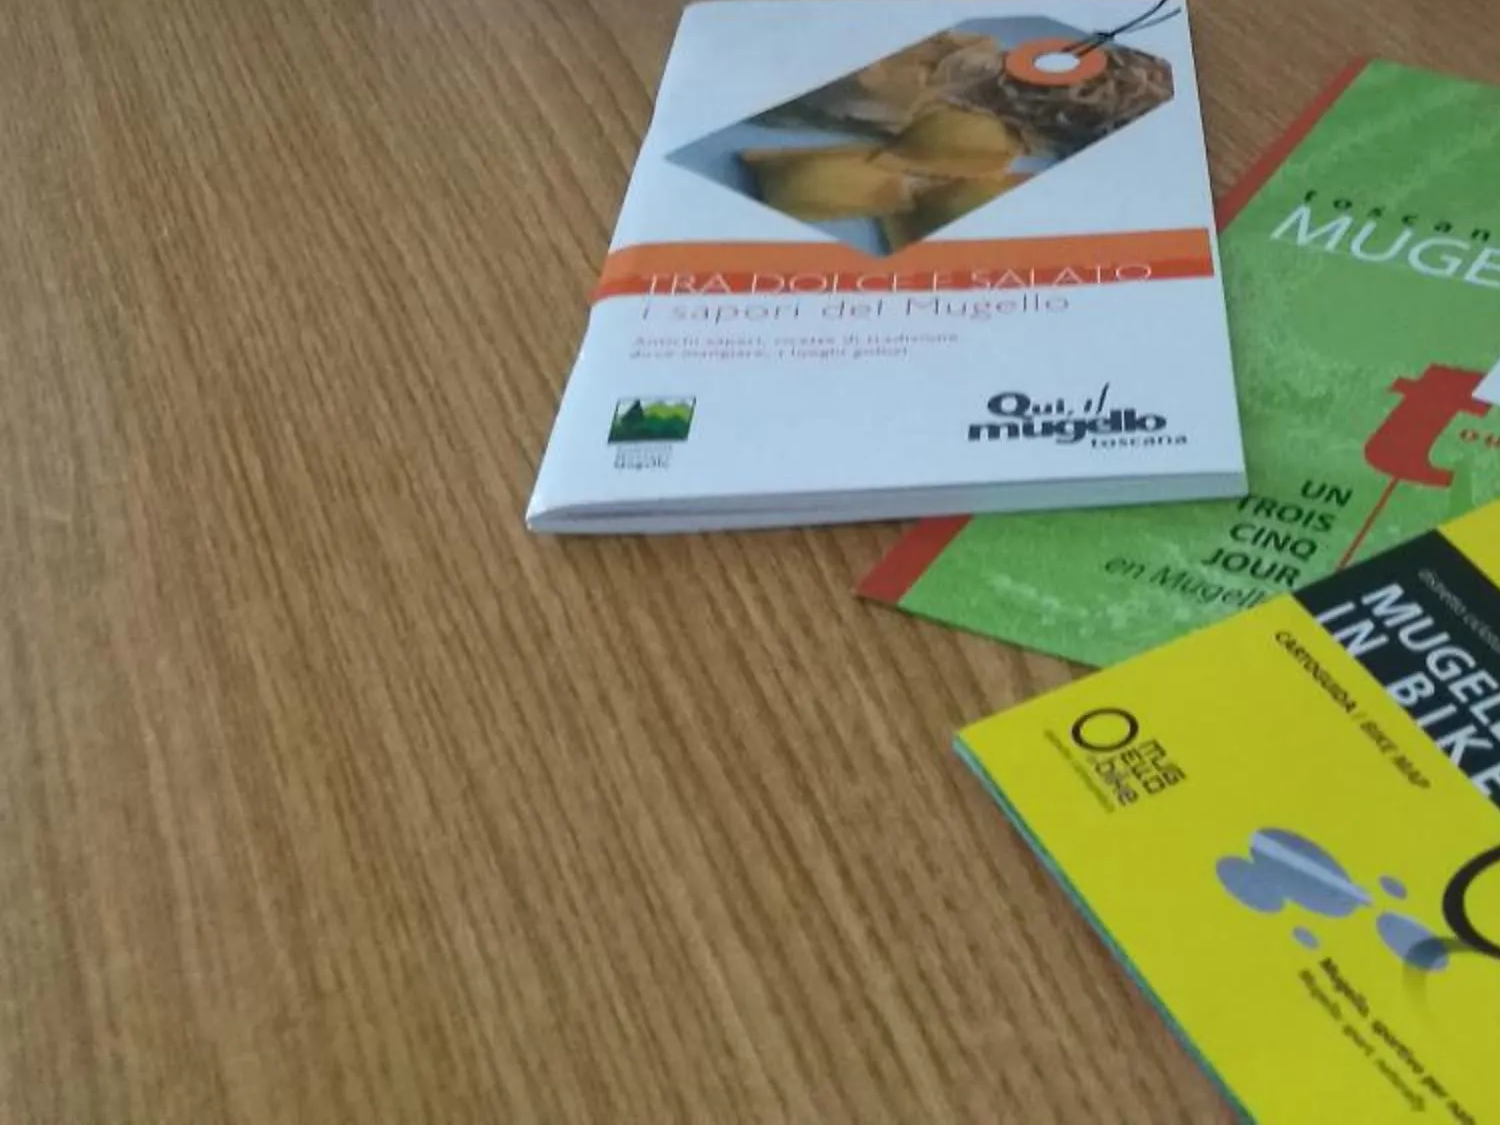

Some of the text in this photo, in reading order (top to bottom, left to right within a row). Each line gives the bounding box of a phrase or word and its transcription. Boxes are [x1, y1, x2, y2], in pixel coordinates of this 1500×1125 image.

[641, 272, 732, 296] TRA
[752, 272, 919, 295] DOLCE
[971, 265, 1152, 291] SALATO
[672, 305, 799, 325] sapori
[822, 298, 883, 318] del
[906, 292, 1069, 320] Mugello
[968, 408, 1167, 445] mugello
[1091, 435, 1188, 449] toscana
[1301, 479, 1353, 508] UN
[1236, 494, 1336, 533] TROIS
[1229, 523, 1318, 562] CINQ
[1104, 556, 1268, 608] en Mugell
[1202, 547, 1302, 588] JOUR
[1312, 600, 1390, 658] IN
